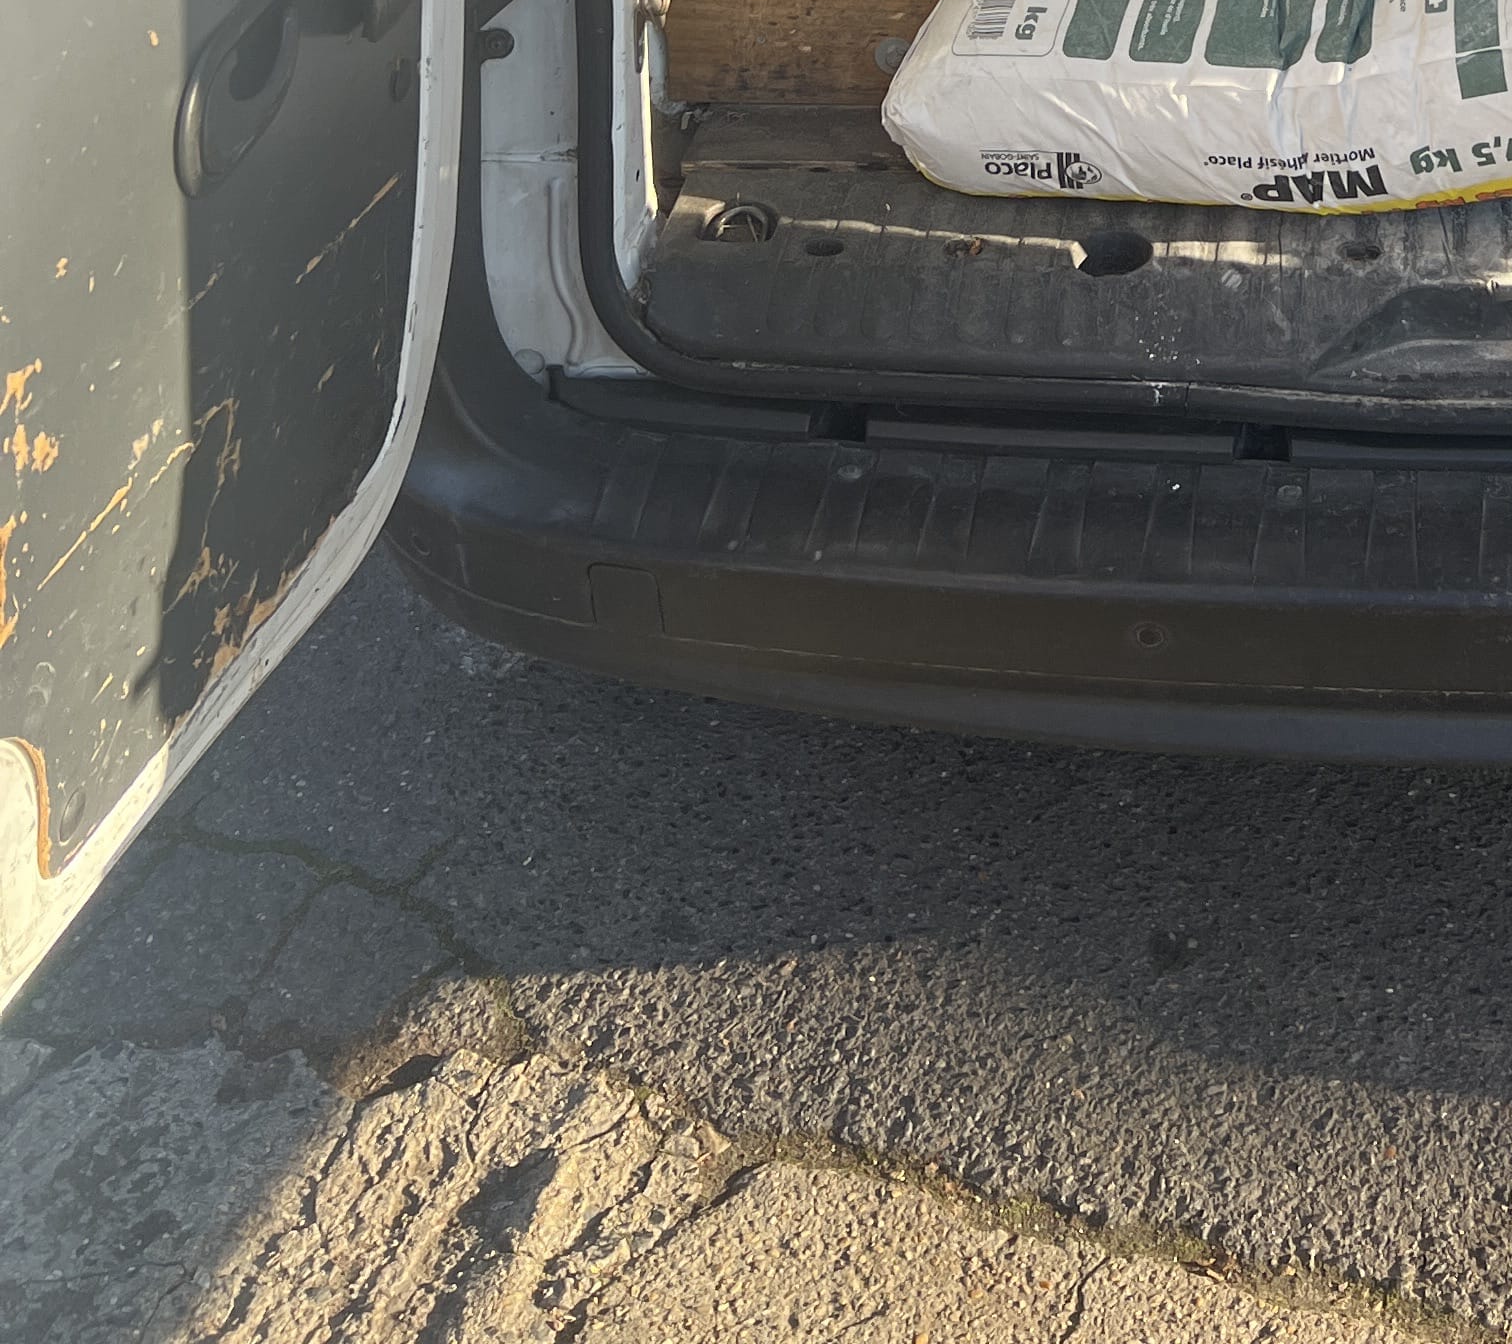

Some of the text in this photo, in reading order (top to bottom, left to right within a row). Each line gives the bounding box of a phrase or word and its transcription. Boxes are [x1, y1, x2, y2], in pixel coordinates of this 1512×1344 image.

[1015, 6, 1048, 40] kg
[981, 153, 1039, 161] SAINT-GOBAIN
[1313, 147, 1375, 163] Mortier
[1409, 146, 1463, 175] kg
[985, 162, 1052, 180] Placo
